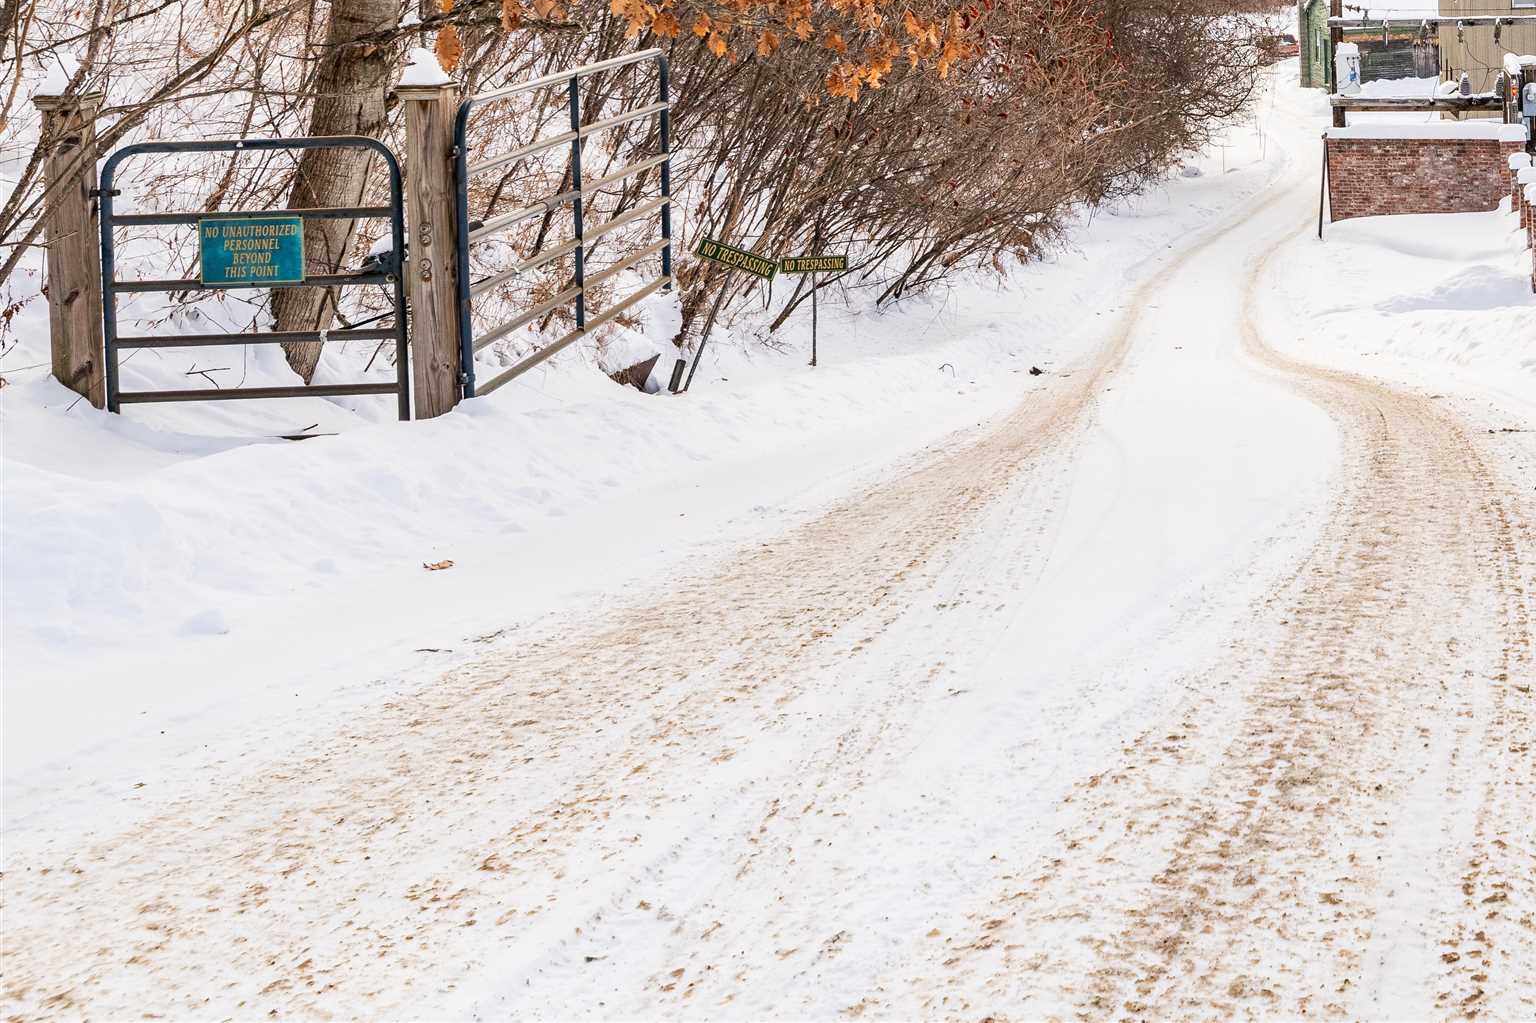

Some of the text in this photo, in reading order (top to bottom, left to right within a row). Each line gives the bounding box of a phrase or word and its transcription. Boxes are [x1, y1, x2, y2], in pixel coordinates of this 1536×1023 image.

[205, 224, 297, 238] NO UNAUTHORIZED
[223, 238, 280, 251] PERSONNEL
[233, 252, 272, 264] BEYOND
[702, 242, 774, 276] NO TRESPASSING
[784, 258, 844, 271] NO TRESPASSING
[224, 265, 280, 278] THIS POINT
